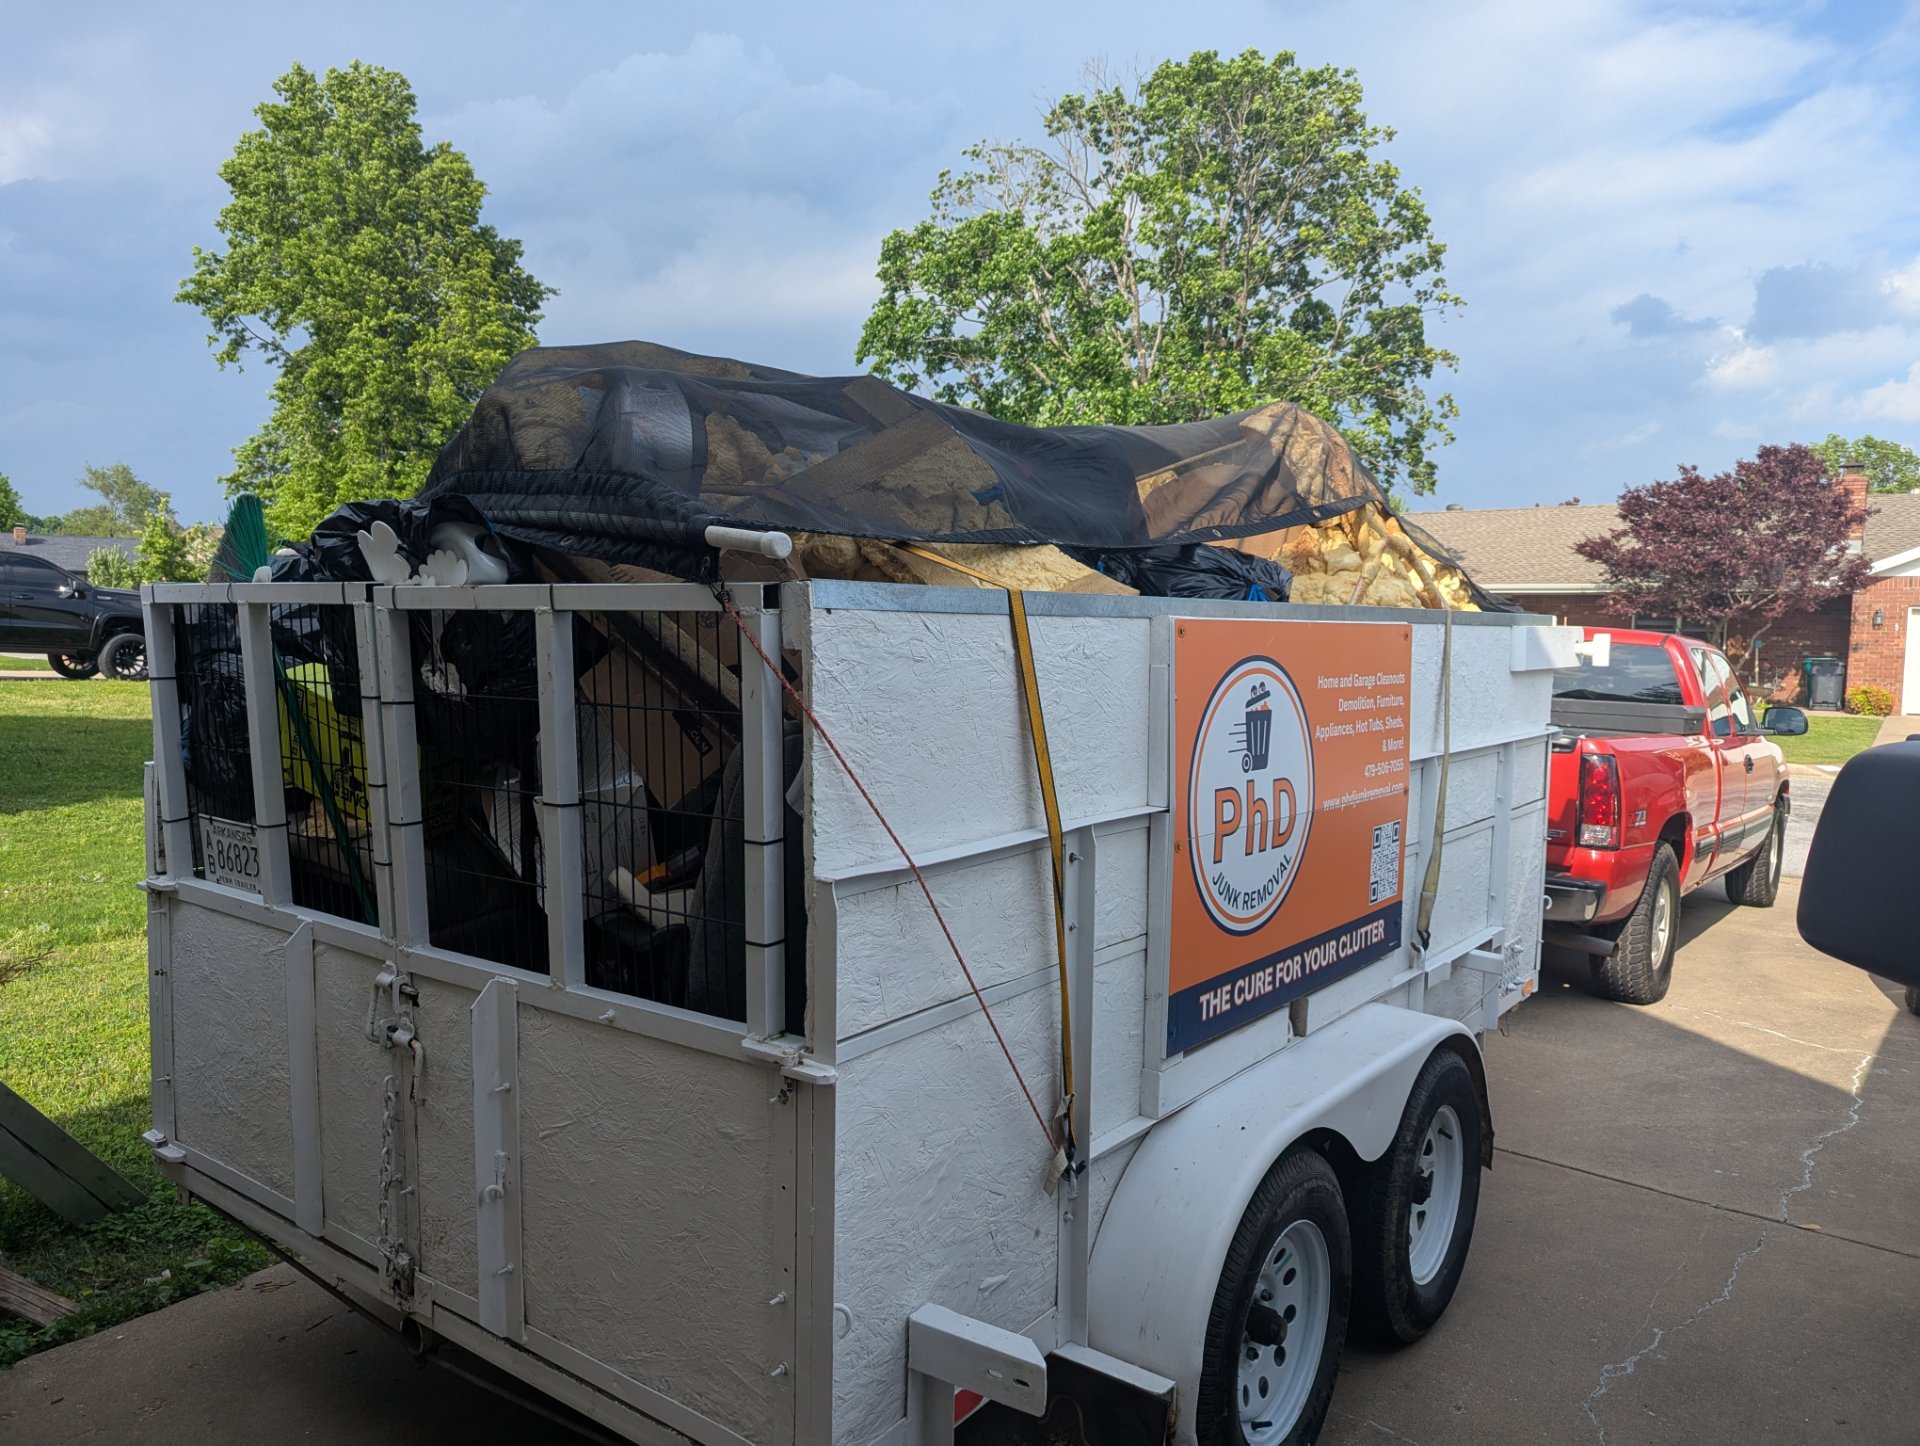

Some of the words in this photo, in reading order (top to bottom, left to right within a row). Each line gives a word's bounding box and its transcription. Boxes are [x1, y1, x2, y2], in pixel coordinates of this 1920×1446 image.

[1317, 675, 1339, 689] Home
[1340, 673, 1353, 688] and
[1353, 673, 1376, 690] Garage
[1376, 672, 1405, 685] Cleanouts
[1338, 696, 1376, 712] Demolition,
[1376, 694, 1405, 708] Furniture,
[1315, 721, 1355, 742] Appliances,
[1355, 719, 1368, 734] Hot
[1368, 718, 1385, 732] Tubs,
[1385, 716, 1405, 730] Sheds,
[1382, 740, 1387, 752] &
[1388, 737, 1404, 751] More!
[213, 824, 253, 843] ARKANSAS
[1213, 777, 1297, 865] PhD
[216, 839, 260, 878] 86823
[1212, 871, 1242, 910] JUNK
[1241, 854, 1292, 911] REMOVAL
[1199, 982, 1232, 1022] THE
[1234, 966, 1273, 1006] CURE
[1275, 955, 1302, 989] FOR
[1303, 938, 1337, 975] YOUR
[1339, 918, 1385, 959] CLUTTER
